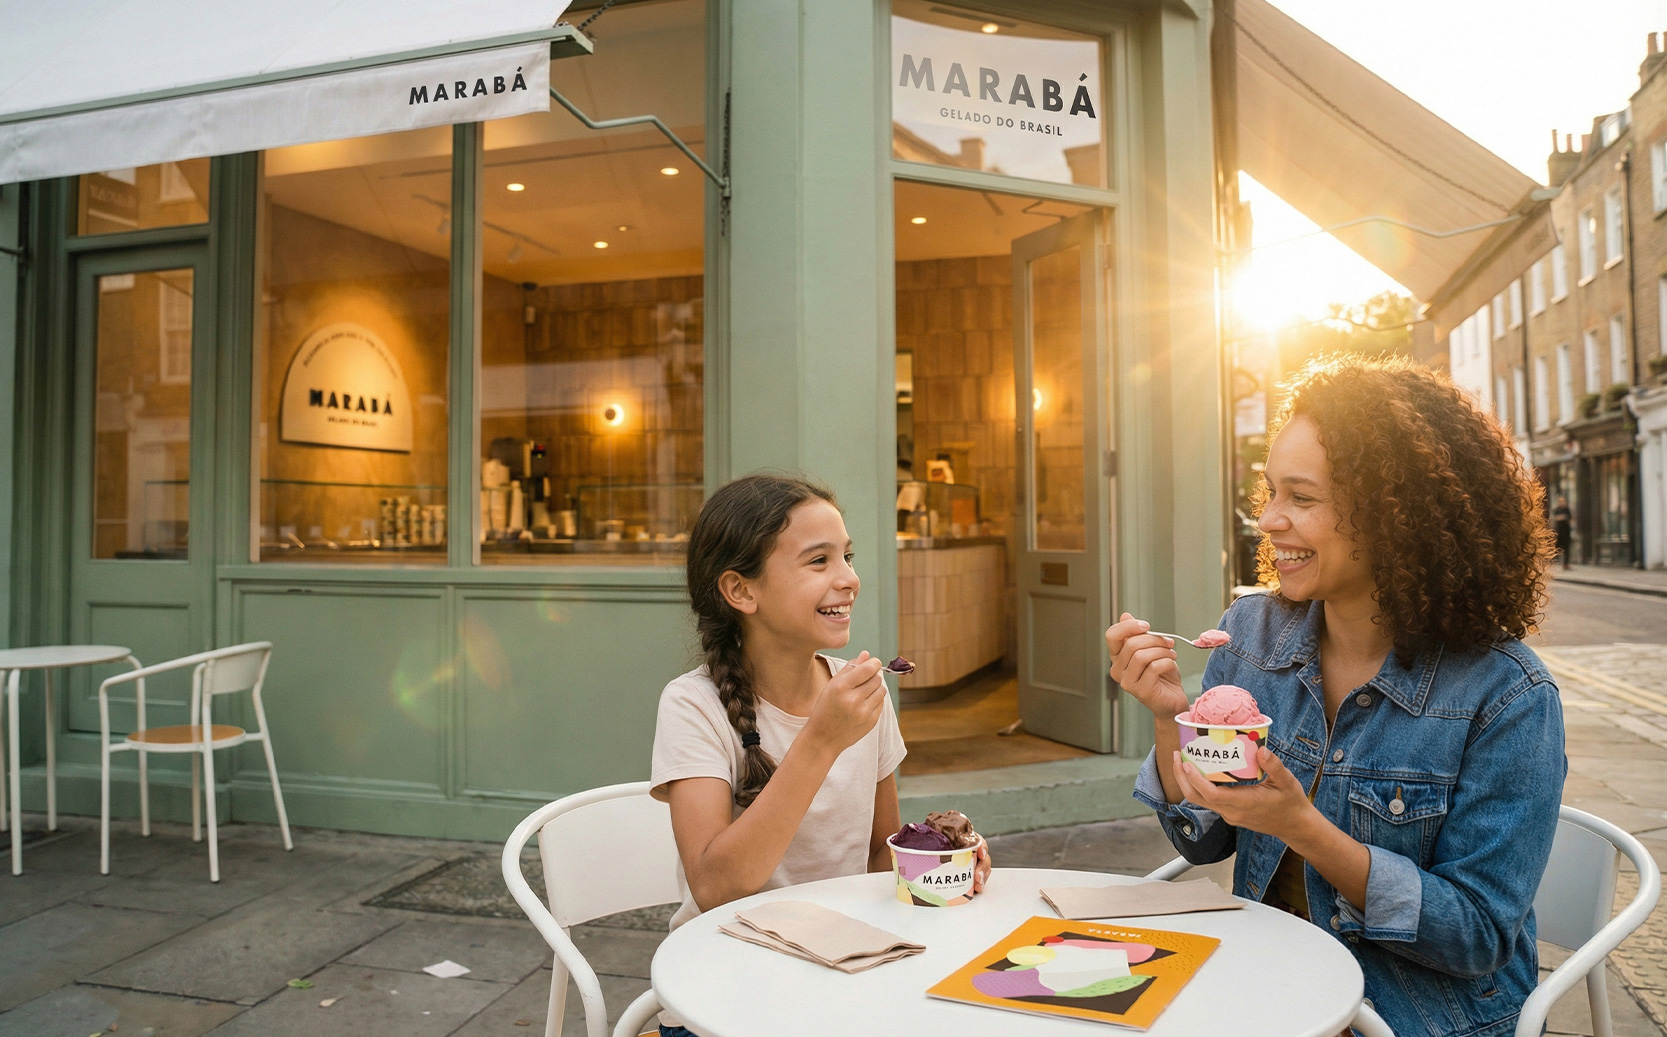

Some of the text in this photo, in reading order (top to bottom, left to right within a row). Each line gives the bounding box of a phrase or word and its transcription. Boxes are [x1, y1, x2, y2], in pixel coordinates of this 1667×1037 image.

[409, 66, 527, 105] MARABÁ
[899, 54, 1096, 118] MARABÁ
[940, 107, 1063, 136] GELADO DO BRASIL
[1187, 746, 1240, 760] MARABÁ
[923, 868, 972, 884] MARABÁ
